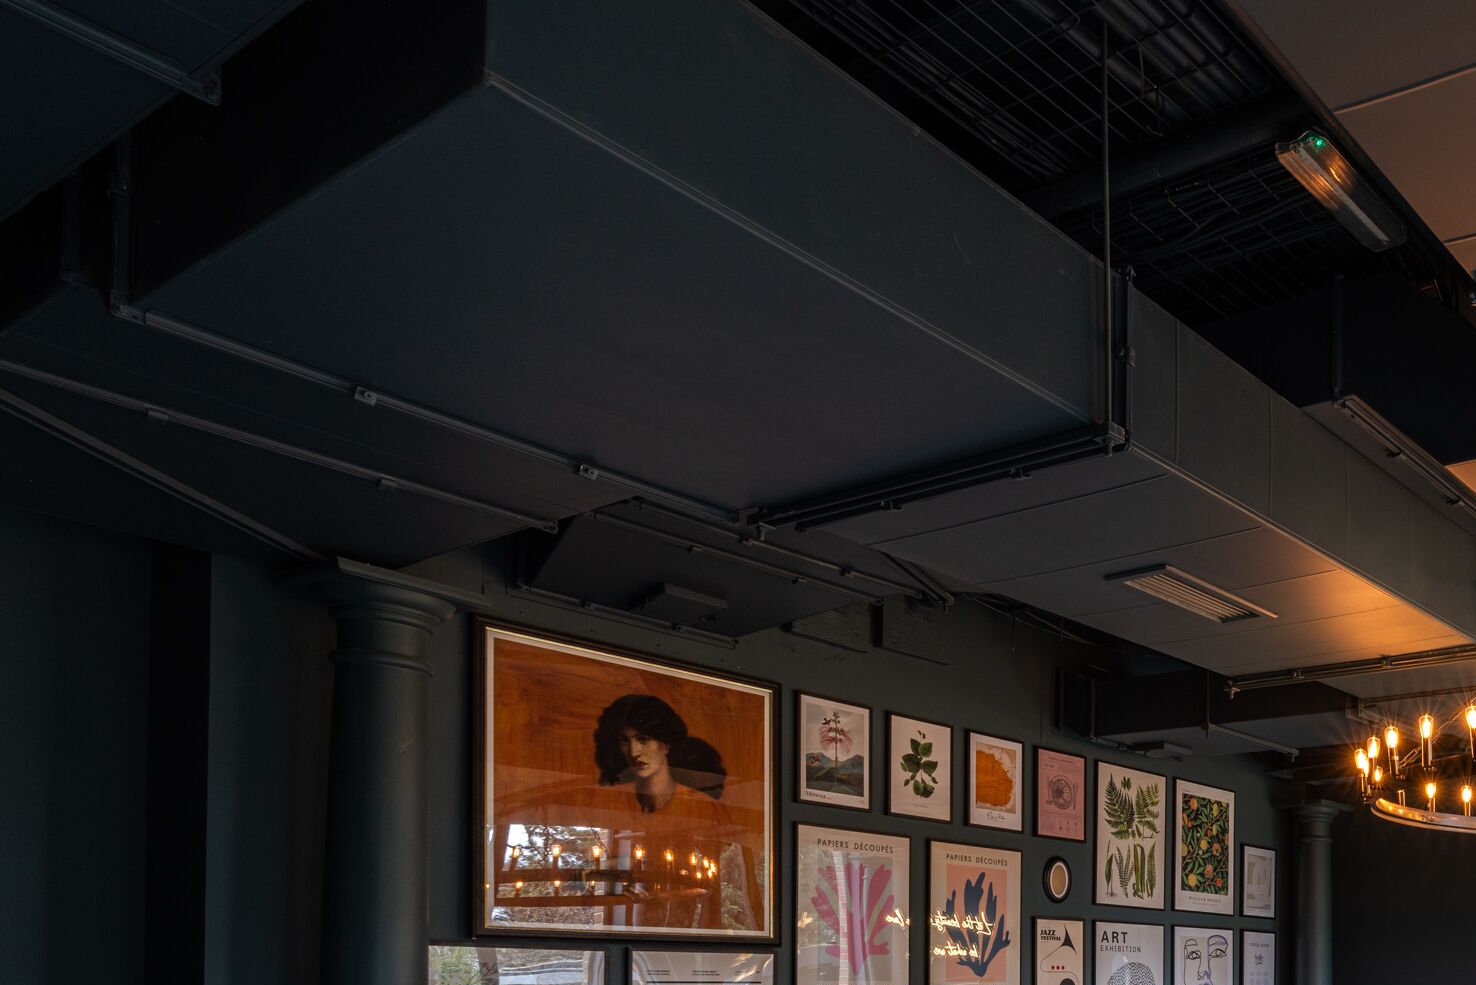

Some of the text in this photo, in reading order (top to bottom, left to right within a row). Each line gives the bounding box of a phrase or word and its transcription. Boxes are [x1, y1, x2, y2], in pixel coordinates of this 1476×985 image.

[816, 838, 894, 854] PAPIERS DÉCOUPÉS
[945, 852, 1009, 867] PAPIERS DÉCOUPÉS
[1100, 930, 1128, 944] ART
[1100, 944, 1142, 953] EXHIBITION
